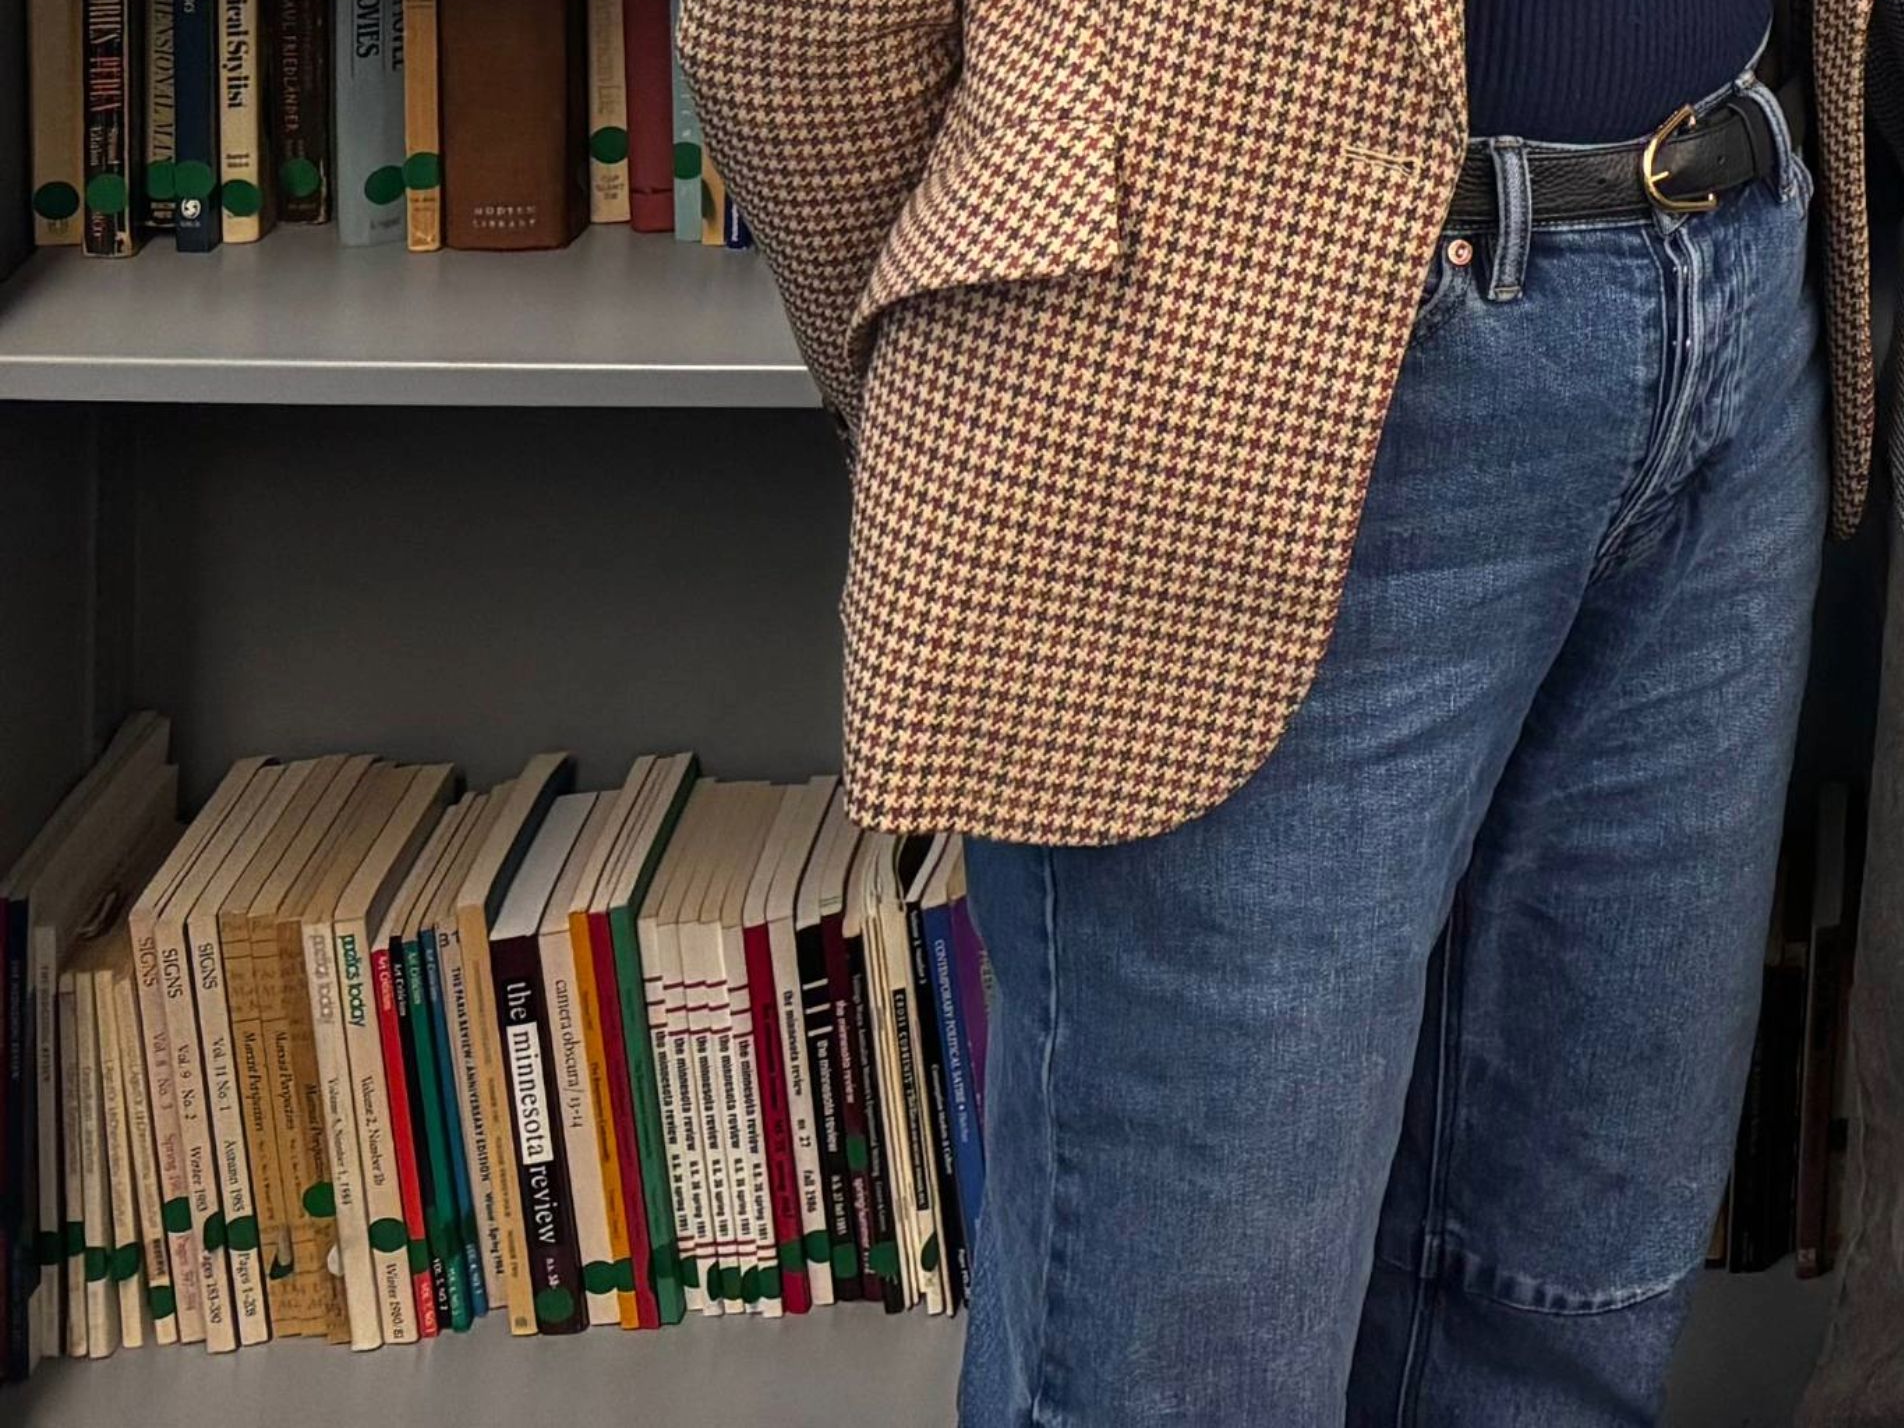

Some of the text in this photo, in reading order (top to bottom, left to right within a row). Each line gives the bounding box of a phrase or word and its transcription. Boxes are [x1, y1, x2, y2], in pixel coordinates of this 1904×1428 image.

[222, 40, 249, 109] Stylist
[506, 981, 556, 1244] the minnesota review
